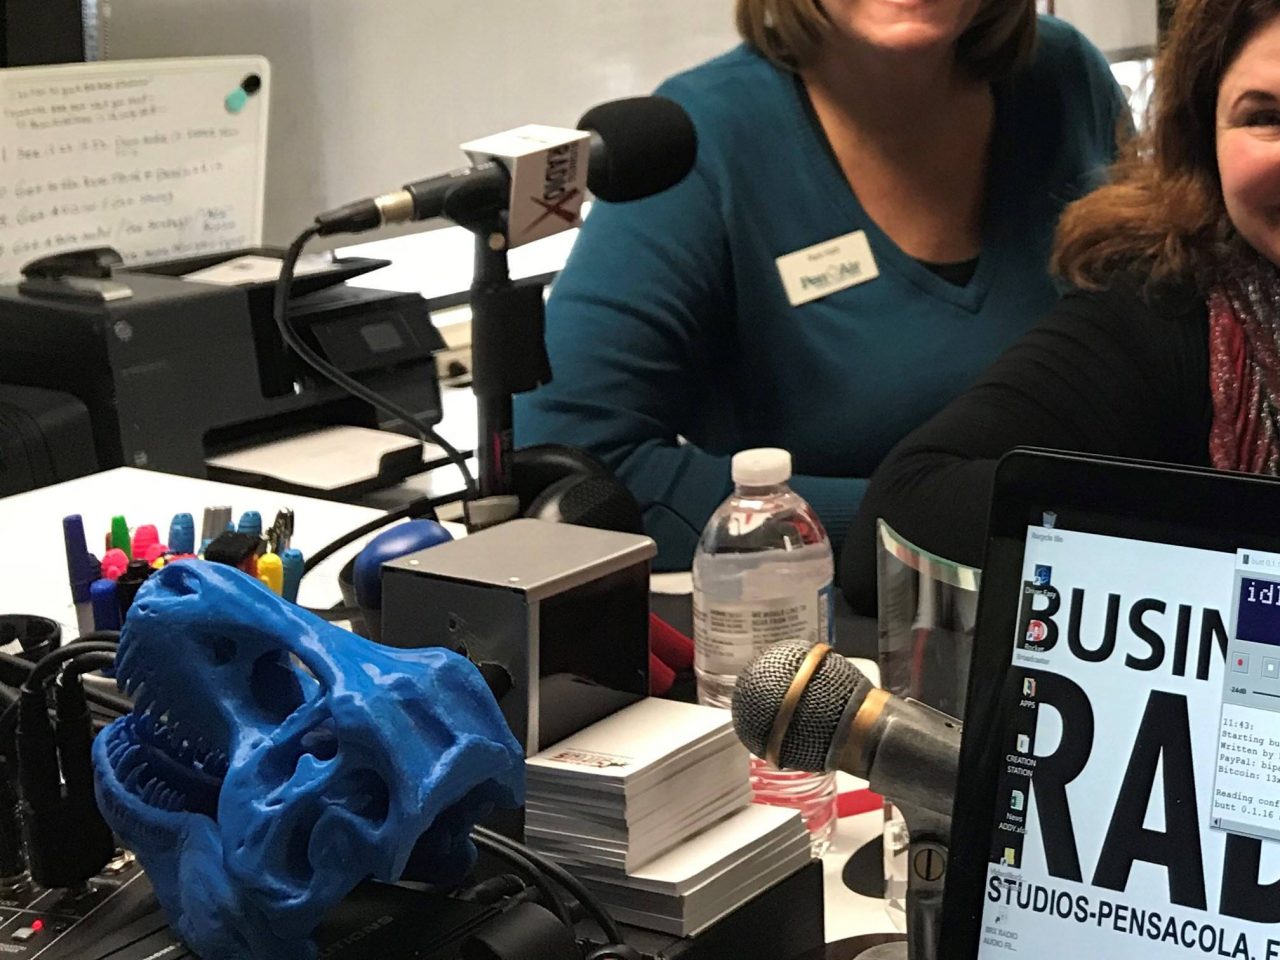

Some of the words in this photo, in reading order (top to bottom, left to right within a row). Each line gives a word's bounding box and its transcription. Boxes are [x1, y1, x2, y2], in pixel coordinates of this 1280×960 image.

[1020, 700, 1035, 708] APPS
[1223, 718, 1254, 730] 11:43:
[1222, 730, 1264, 746] Starting
[1221, 742, 1257, 755] Written
[1262, 749, 1274, 760] by
[1006, 754, 1036, 767] CREATION
[1220, 754, 1256, 767] PayPal:
[1008, 766, 1033, 777] STATION
[1218, 765, 1260, 780] Bitcoin:
[1216, 789, 1253, 804] Reading
[1214, 800, 1236, 811] butt
[1241, 806, 1274, 818] 0.1.16
[1007, 812, 1022, 822] News
